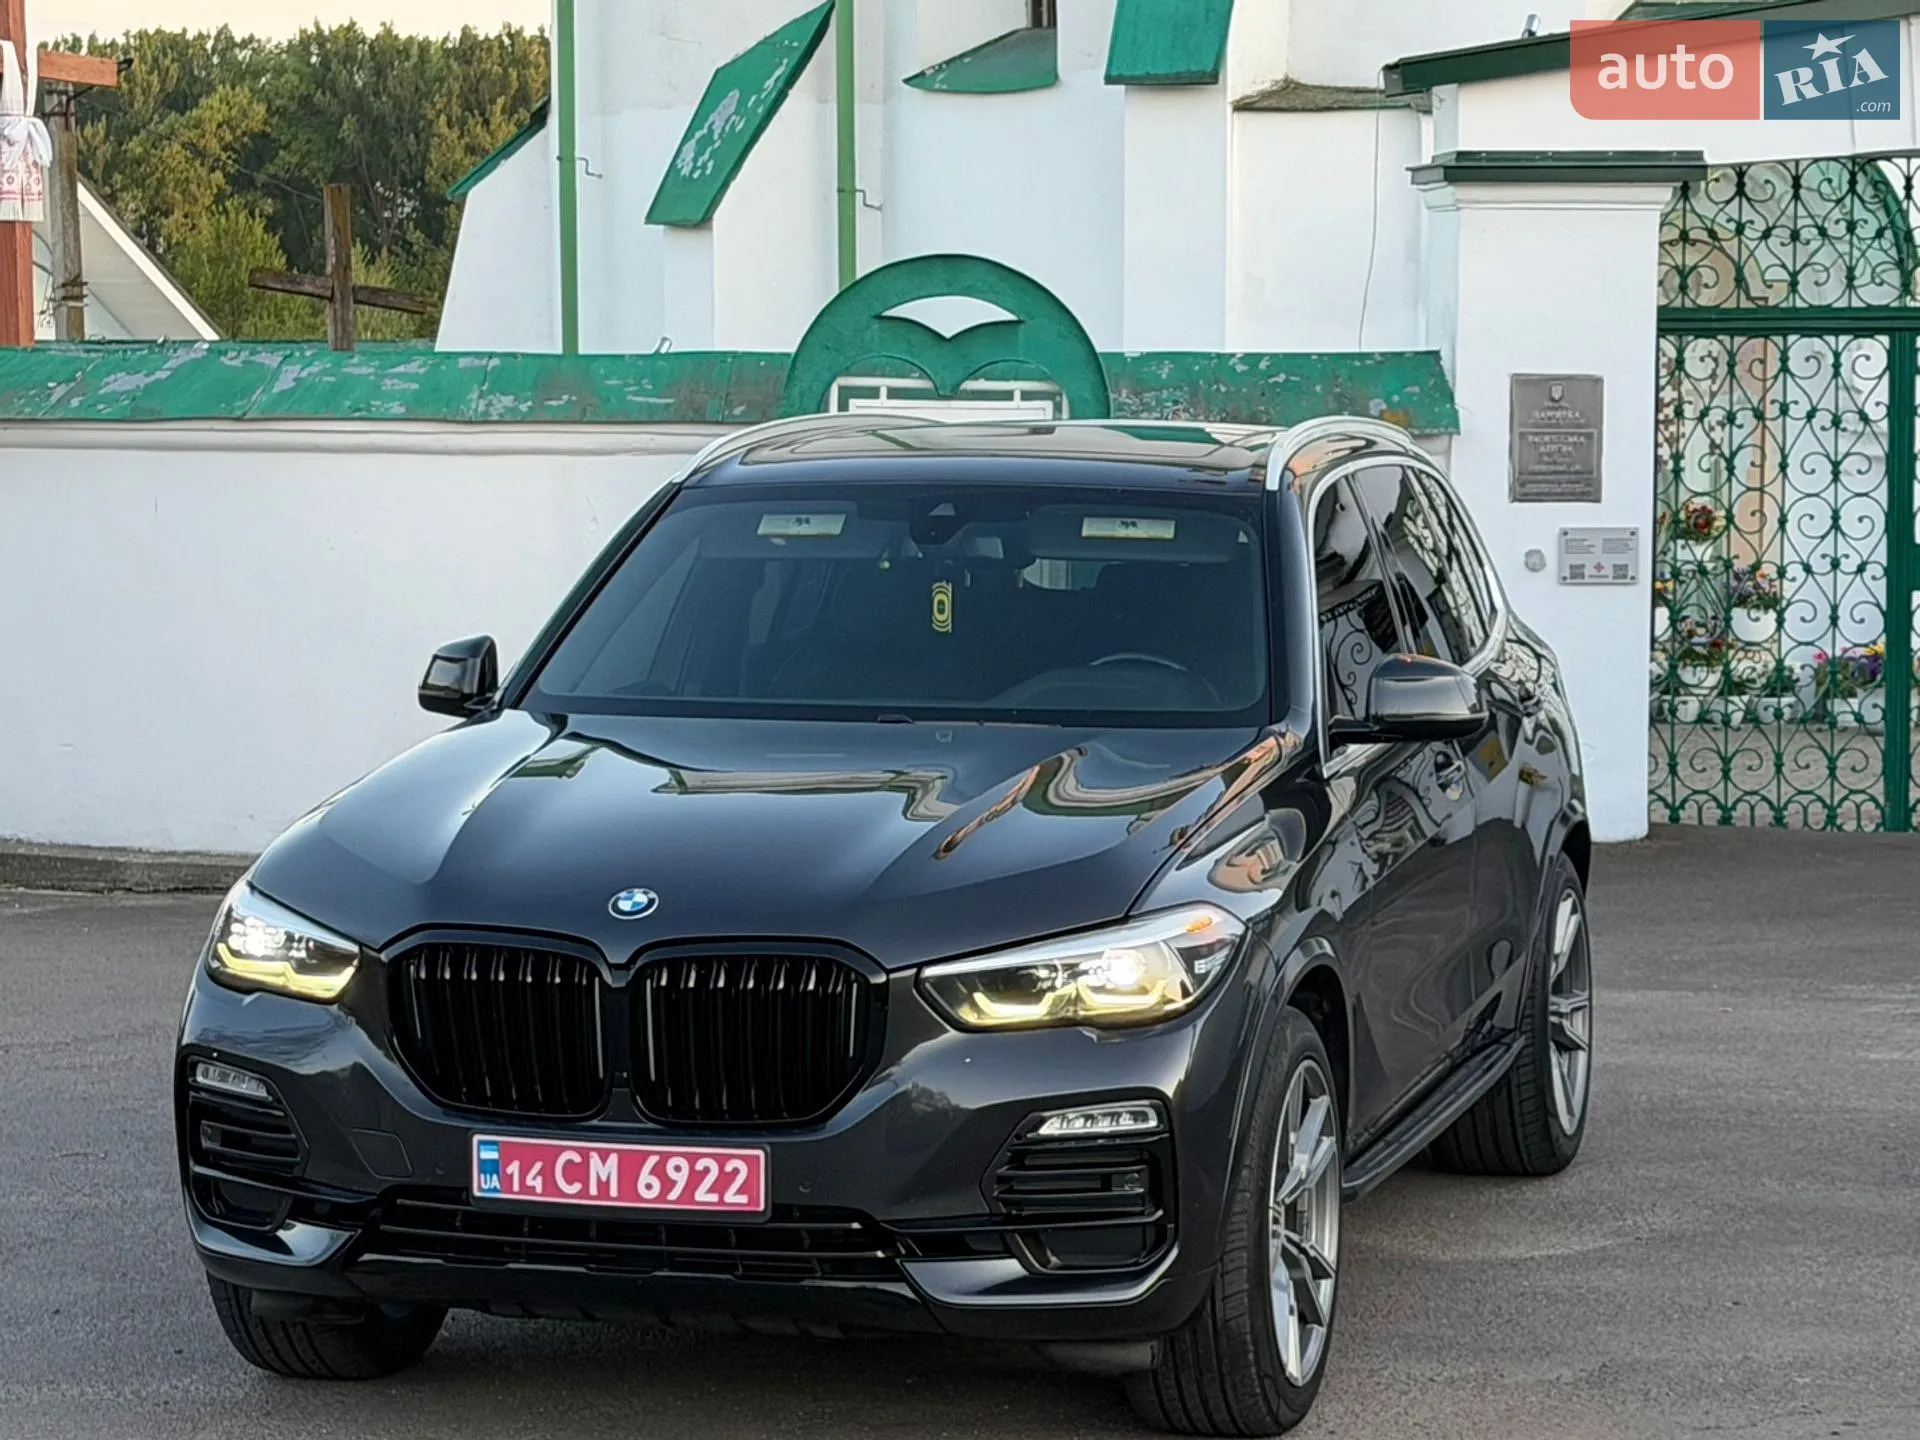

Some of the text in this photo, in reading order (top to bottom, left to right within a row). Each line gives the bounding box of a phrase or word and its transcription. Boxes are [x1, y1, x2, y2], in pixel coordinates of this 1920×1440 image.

[480, 1173, 501, 1190] UA
[505, 1150, 749, 1204] 14 CM 6922
